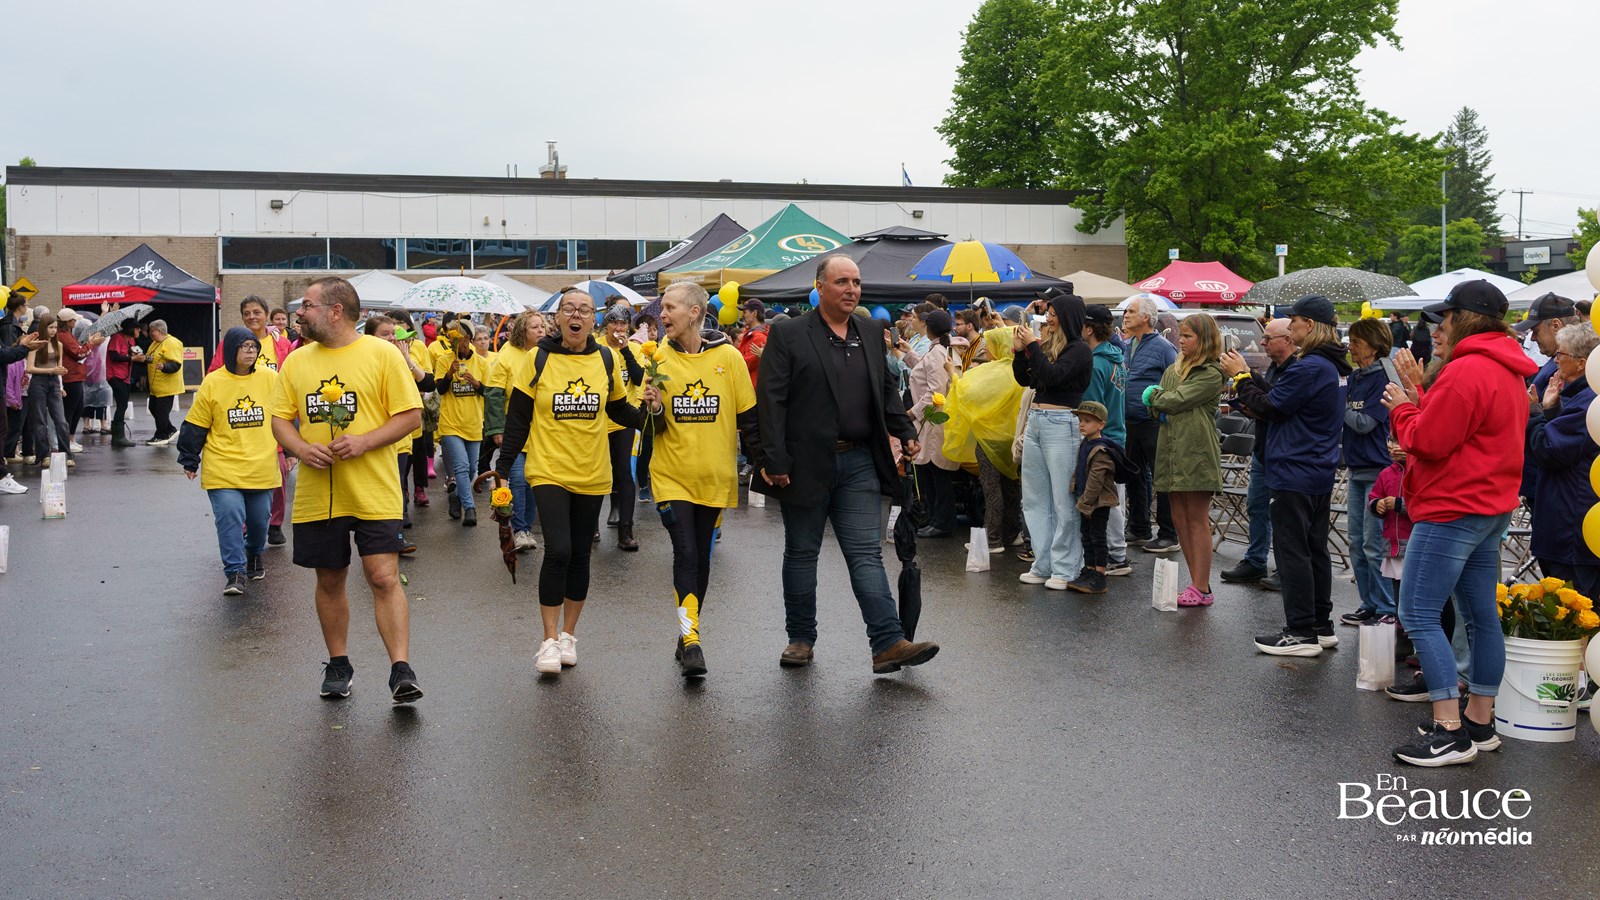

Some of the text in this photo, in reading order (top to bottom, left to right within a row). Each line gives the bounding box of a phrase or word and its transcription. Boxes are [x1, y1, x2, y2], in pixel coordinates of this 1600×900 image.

[111, 260, 155, 280] Rock
[133, 268, 163, 283] Café
[1199, 283, 1224, 291] KIA
[69, 291, 125, 300] PUBROCKCAFE.COM
[554, 394, 599, 405] RELAIS
[673, 397, 718, 408] RELAIS
[228, 407, 263, 417] RELAIS
[308, 406, 330, 414] POR
